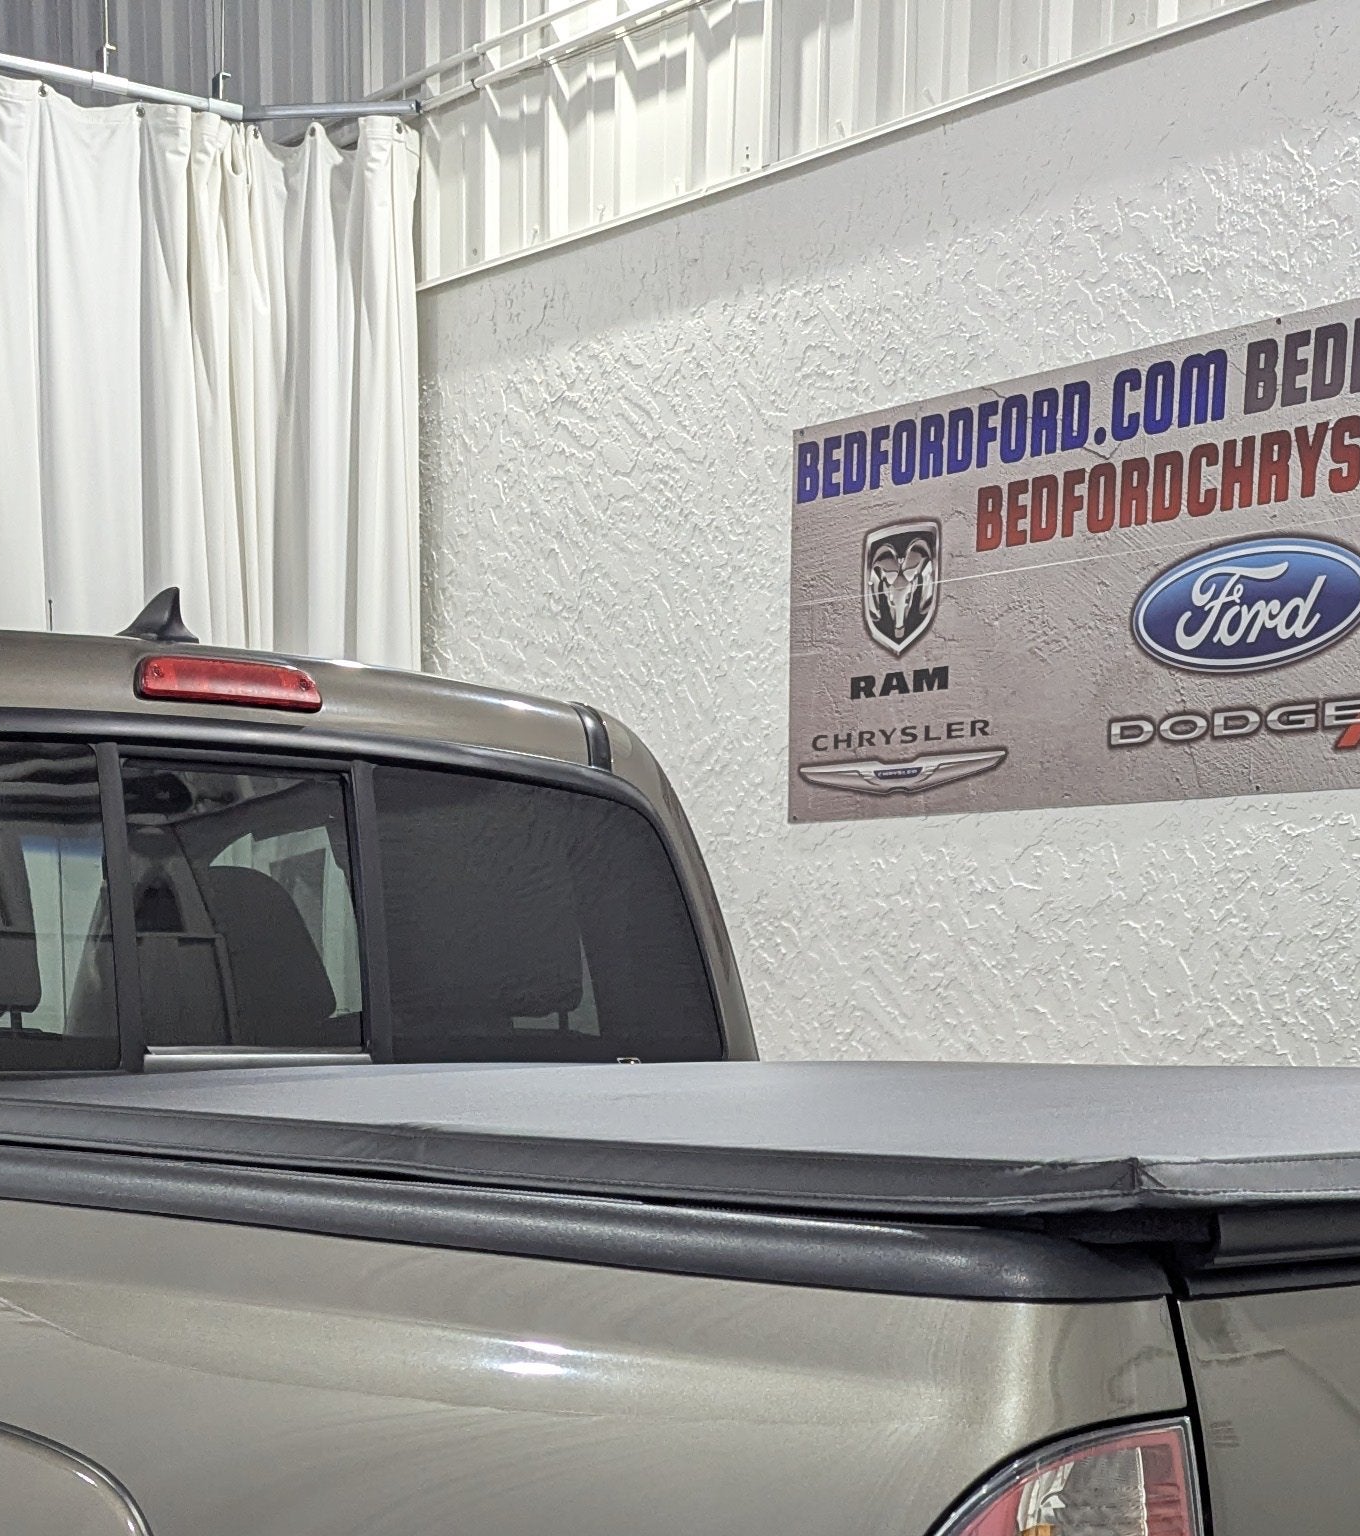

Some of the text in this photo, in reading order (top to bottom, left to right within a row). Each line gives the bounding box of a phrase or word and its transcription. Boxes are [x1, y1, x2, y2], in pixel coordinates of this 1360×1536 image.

[796, 348, 1228, 504] BEDFORDFORD.COM
[1174, 561, 1328, 651] Ford
[849, 665, 950, 699] RAM
[811, 718, 991, 753] CHRYSLER
